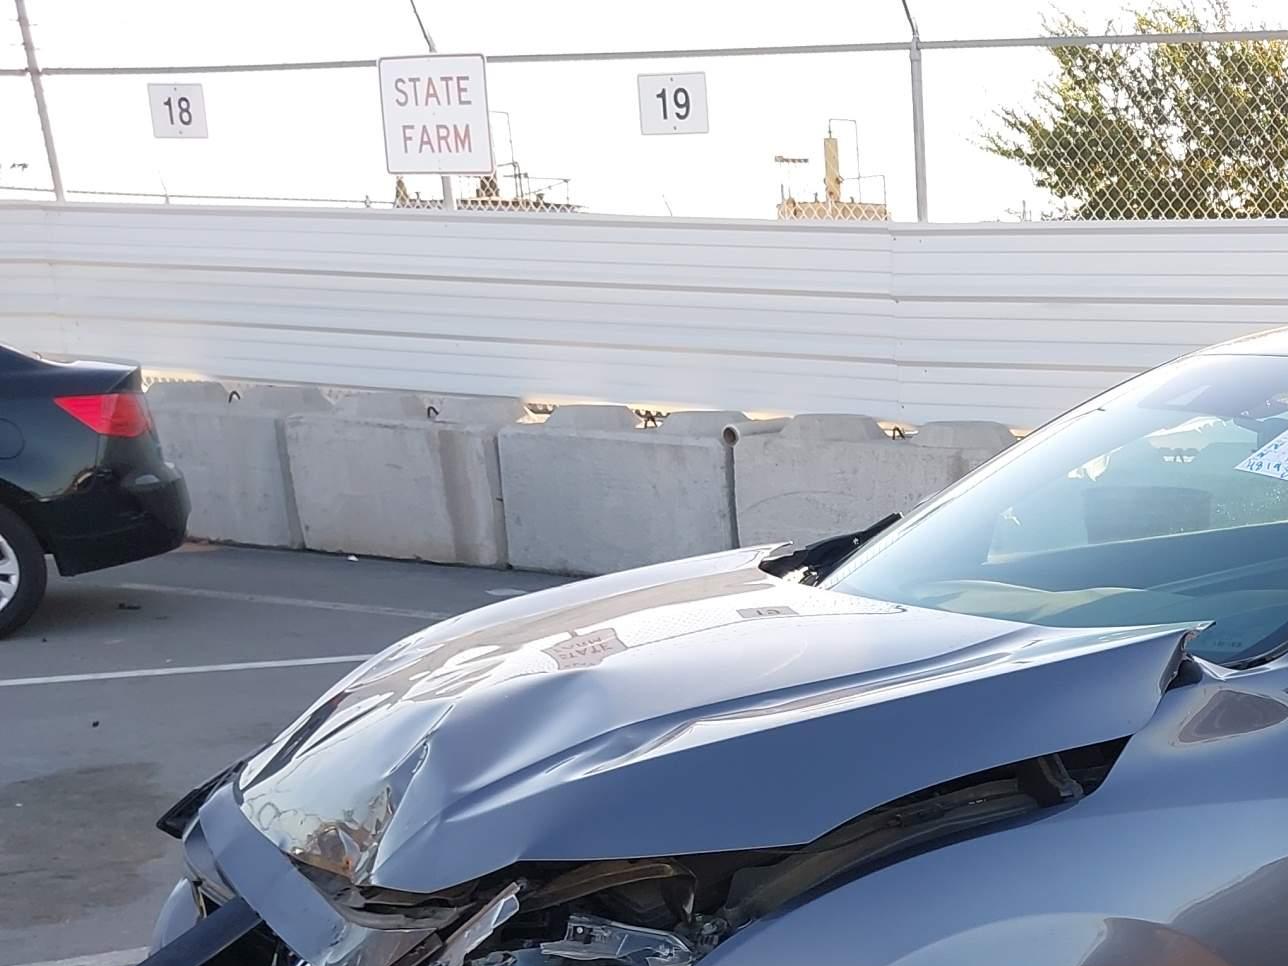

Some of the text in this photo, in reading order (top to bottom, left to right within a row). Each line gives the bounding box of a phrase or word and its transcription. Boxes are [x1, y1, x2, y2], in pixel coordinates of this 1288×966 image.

[394, 76, 472, 107] STATE
[656, 87, 690, 120] 19
[163, 96, 192, 126] 18
[402, 123, 472, 154] FARM
